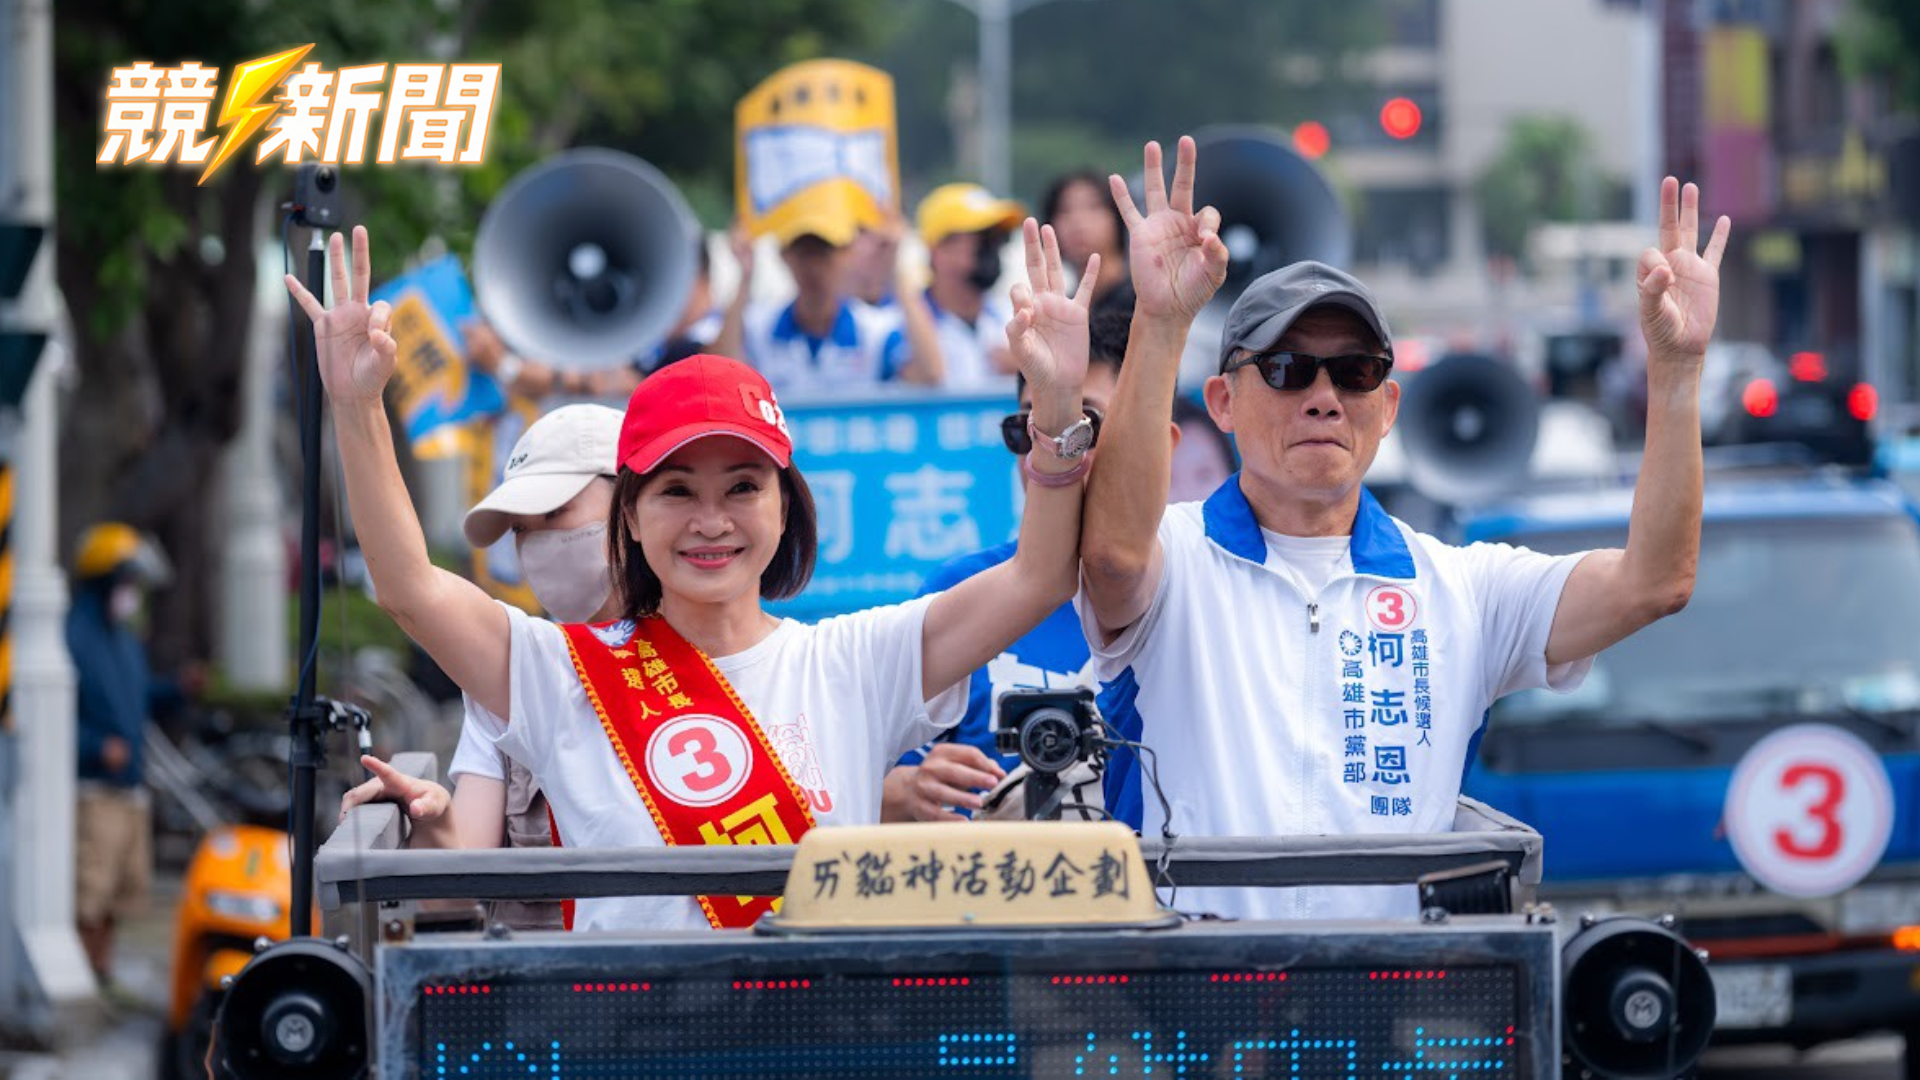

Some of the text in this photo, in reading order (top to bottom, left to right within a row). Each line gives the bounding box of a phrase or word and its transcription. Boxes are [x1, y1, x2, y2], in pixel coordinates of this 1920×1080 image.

[1377, 591, 1405, 625] 3
[634, 639, 694, 709] 高雄市長
[1368, 630, 1411, 785] 柯志恩
[1410, 629, 1432, 747] 高雄市長候選人
[668, 727, 732, 792] 3
[1342, 659, 1366, 783] 高雄市黨部
[1370, 795, 1413, 816] 團隊
[1775, 763, 1845, 860] 3
